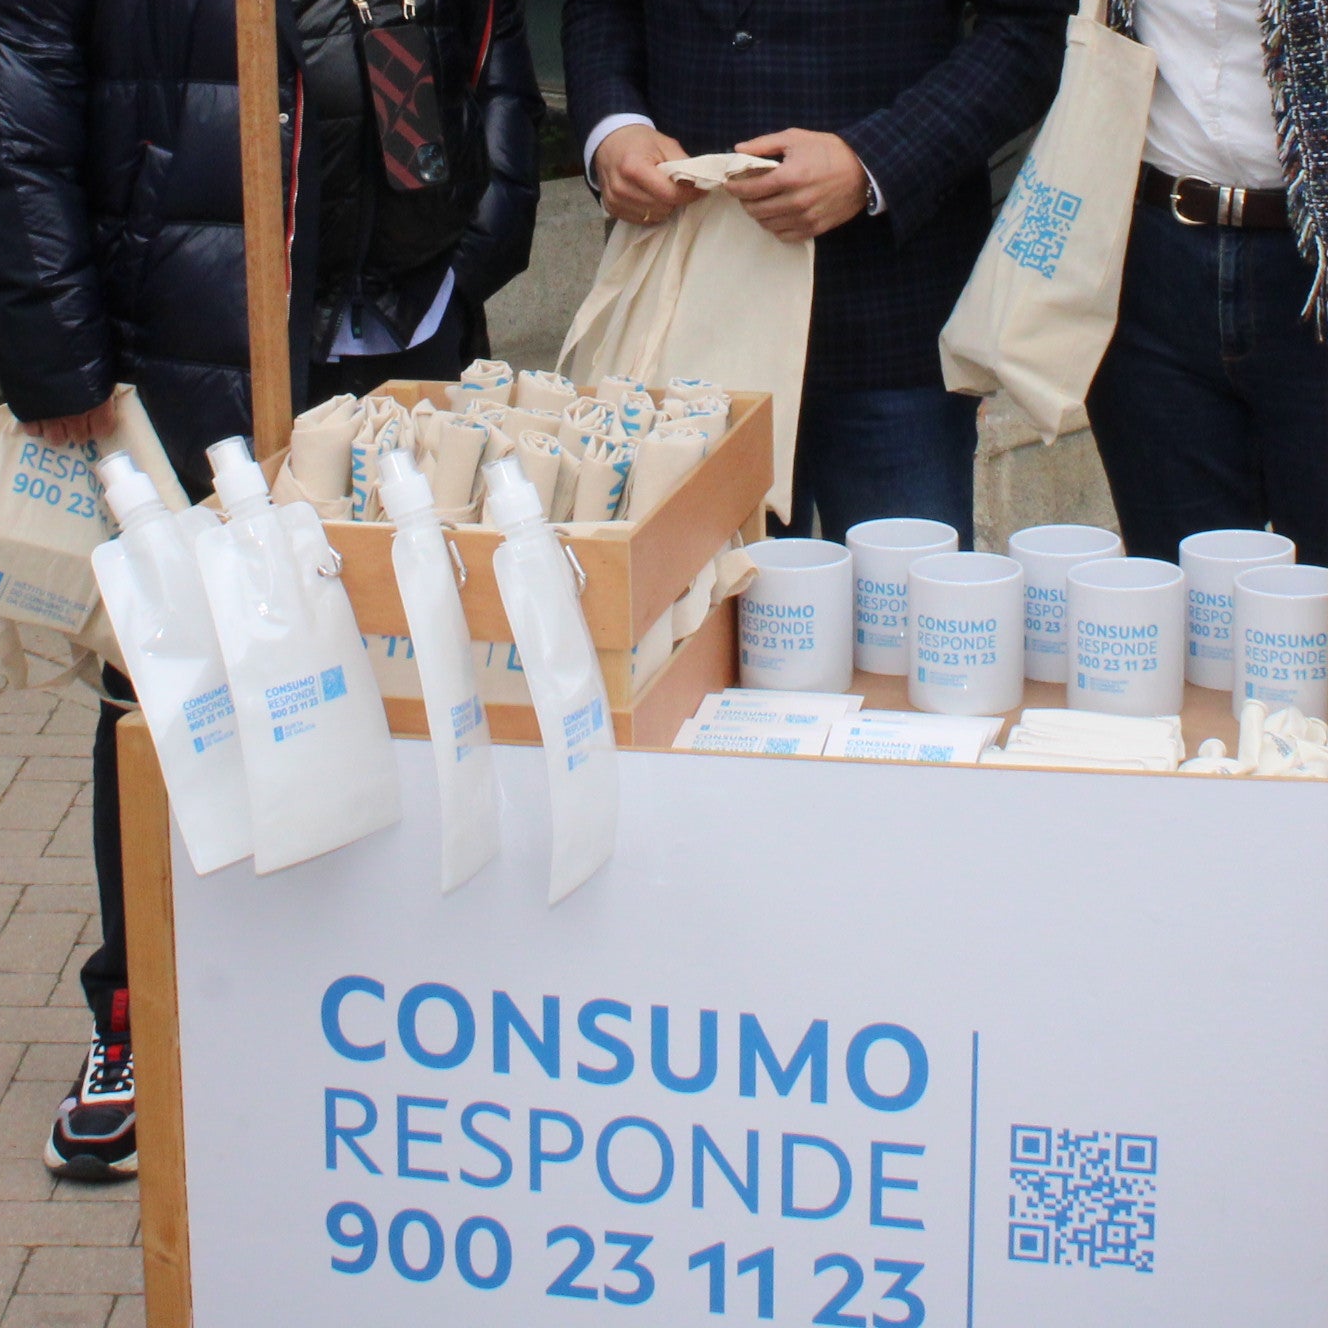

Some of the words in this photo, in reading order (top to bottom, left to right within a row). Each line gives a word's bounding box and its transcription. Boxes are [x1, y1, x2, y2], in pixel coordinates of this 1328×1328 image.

[11, 473, 62, 506] 900
[65, 492, 96, 519] 23
[741, 598, 816, 619] CONSUMO
[741, 614, 815, 635] RESPONDE
[882, 615, 898, 627] 23
[918, 614, 997, 634] CONSUMO
[1045, 621, 1060, 633] 23
[1077, 620, 1159, 640] CONSUMO
[917, 631, 996, 651] RESPONDE
[1213, 627, 1229, 639] 23
[1245, 629, 1328, 648] CONSUMO
[762, 637, 777, 649] 23
[781, 639, 794, 650] 11
[798, 638, 815, 650] 23
[1077, 636, 1158, 656] RESPONDE
[918, 647, 940, 663] 900
[943, 653, 959, 665] 23
[964, 654, 977, 665] 11
[981, 653, 996, 665] 23
[1077, 653, 1100, 669] 900
[1103, 659, 1120, 671] 23
[1125, 660, 1138, 671] 11
[1142, 658, 1158, 671] 23
[1245, 645, 1327, 665] RESPONDE
[1245, 662, 1268, 678] 900
[1272, 668, 1289, 680] 23
[1294, 669, 1307, 680] 11
[1311, 667, 1328, 680] 23
[183, 683, 228, 710] CONSUMO
[265, 675, 315, 698] CONSUMO
[267, 686, 317, 709] RESPONDE
[320, 974, 931, 1112] CONSUMO
[323, 1085, 927, 1232] RESPONDE
[323, 1200, 513, 1291] 900
[545, 1224, 656, 1306] 23
[687, 1241, 774, 1320] 11
[811, 1252, 926, 1328] 23
